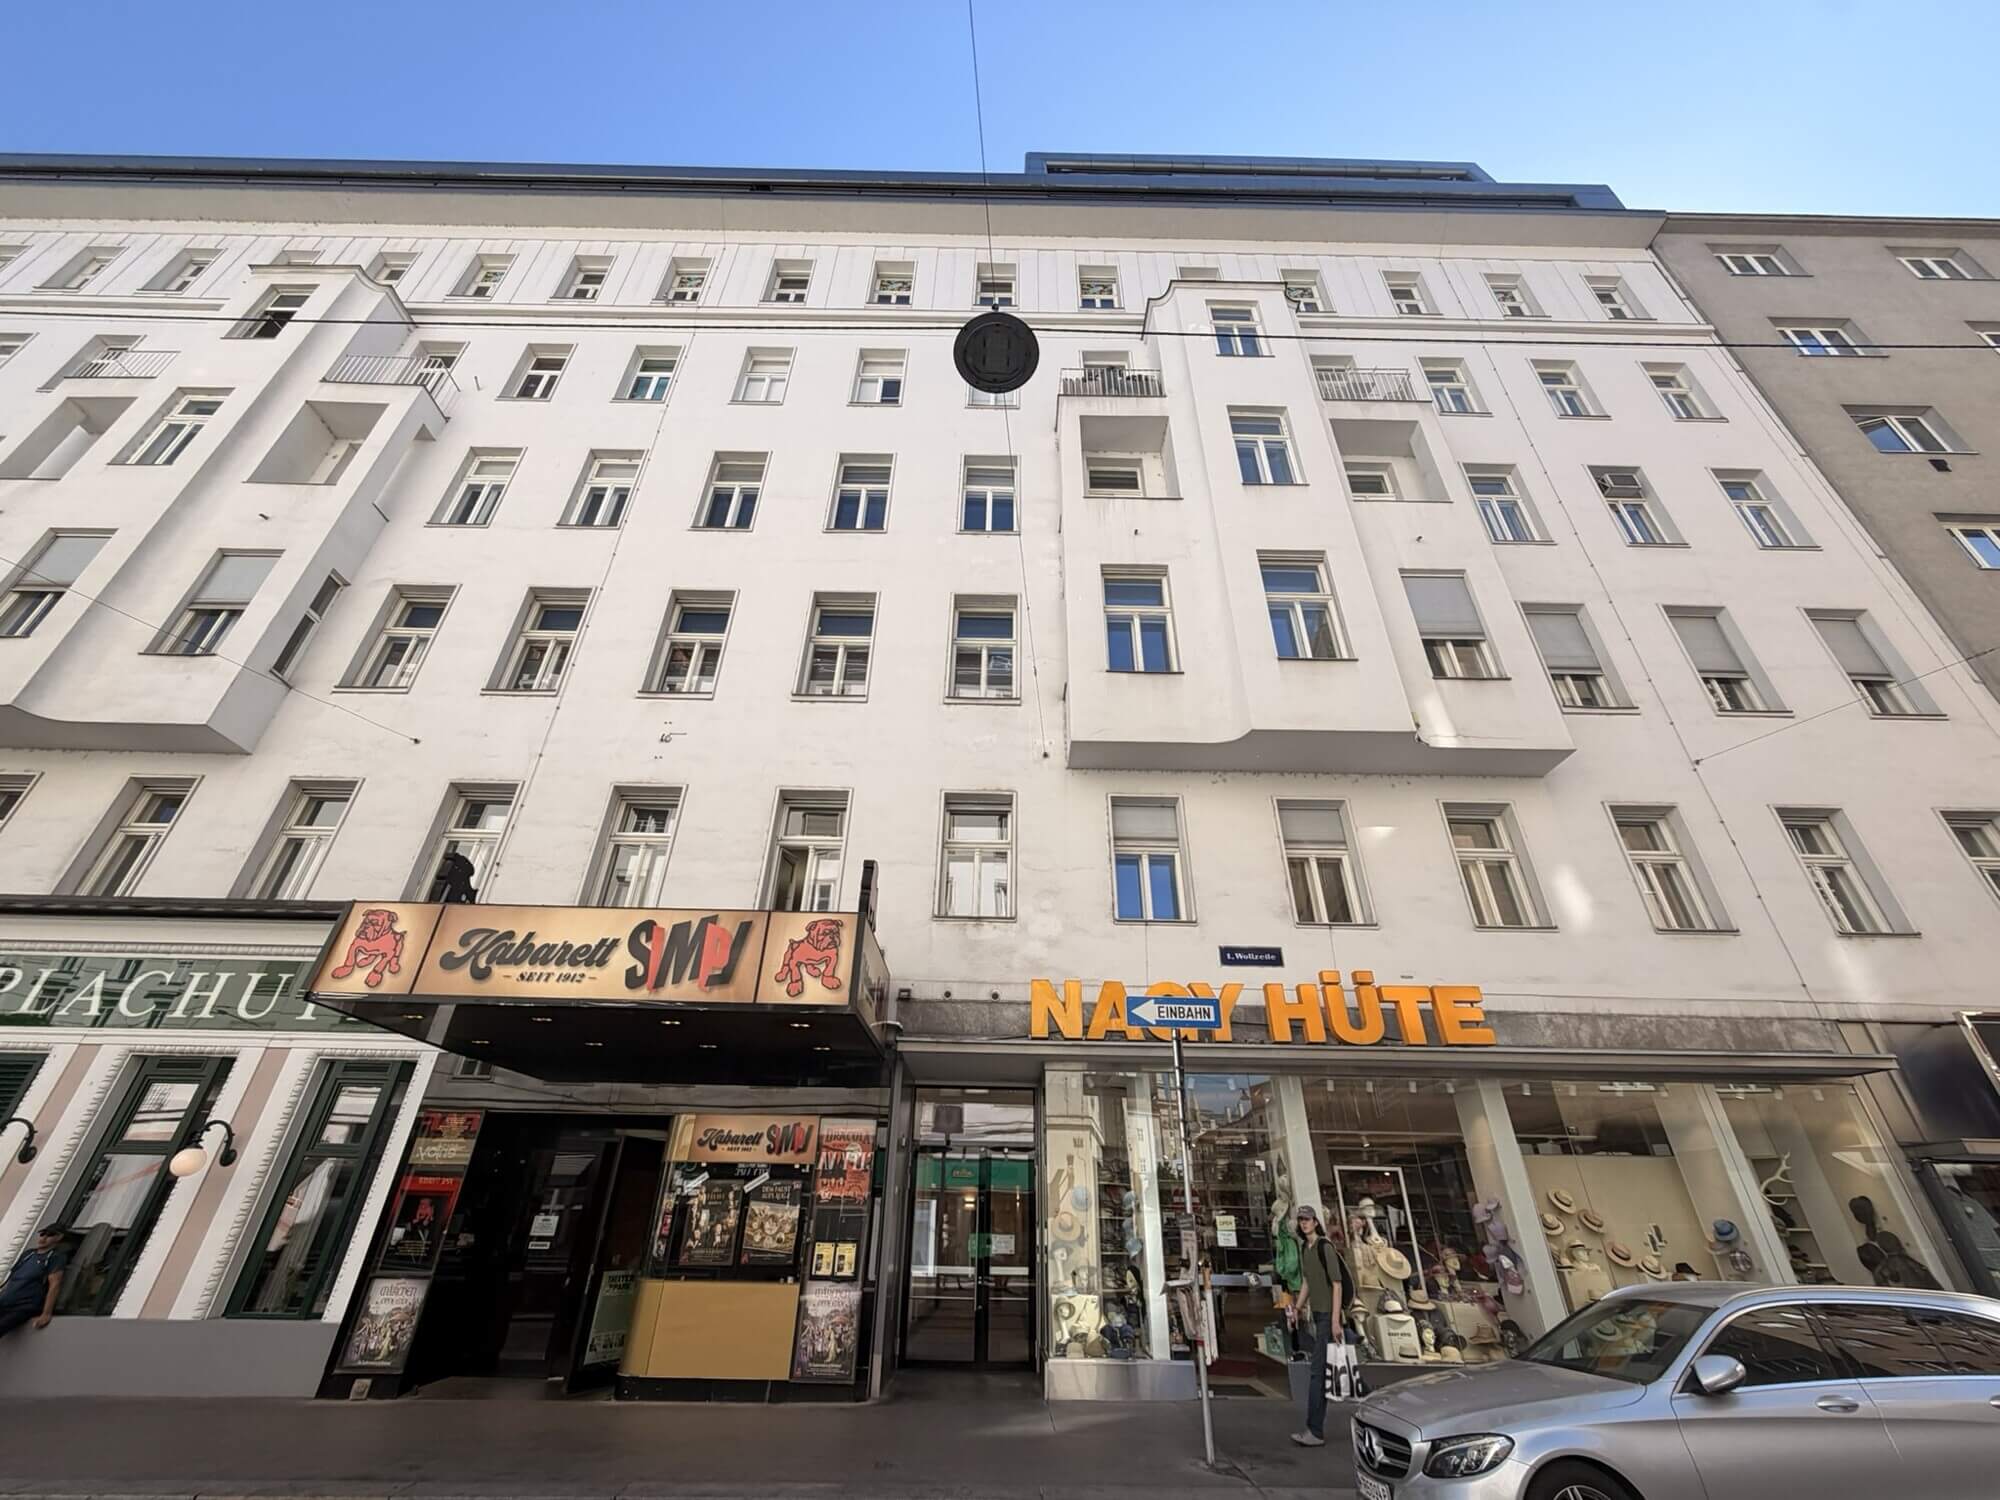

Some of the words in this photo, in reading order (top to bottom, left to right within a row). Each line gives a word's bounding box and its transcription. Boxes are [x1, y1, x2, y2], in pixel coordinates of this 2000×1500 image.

[440, 927, 621, 981] Kabarett
[516, 971, 554, 983] SEIT
[556, 972, 586, 984] 1912
[0, 966, 358, 1022] PLACHU
[1157, 1005, 1211, 1020] EINBAHN
[1263, 969, 1496, 1047] HÜTE
